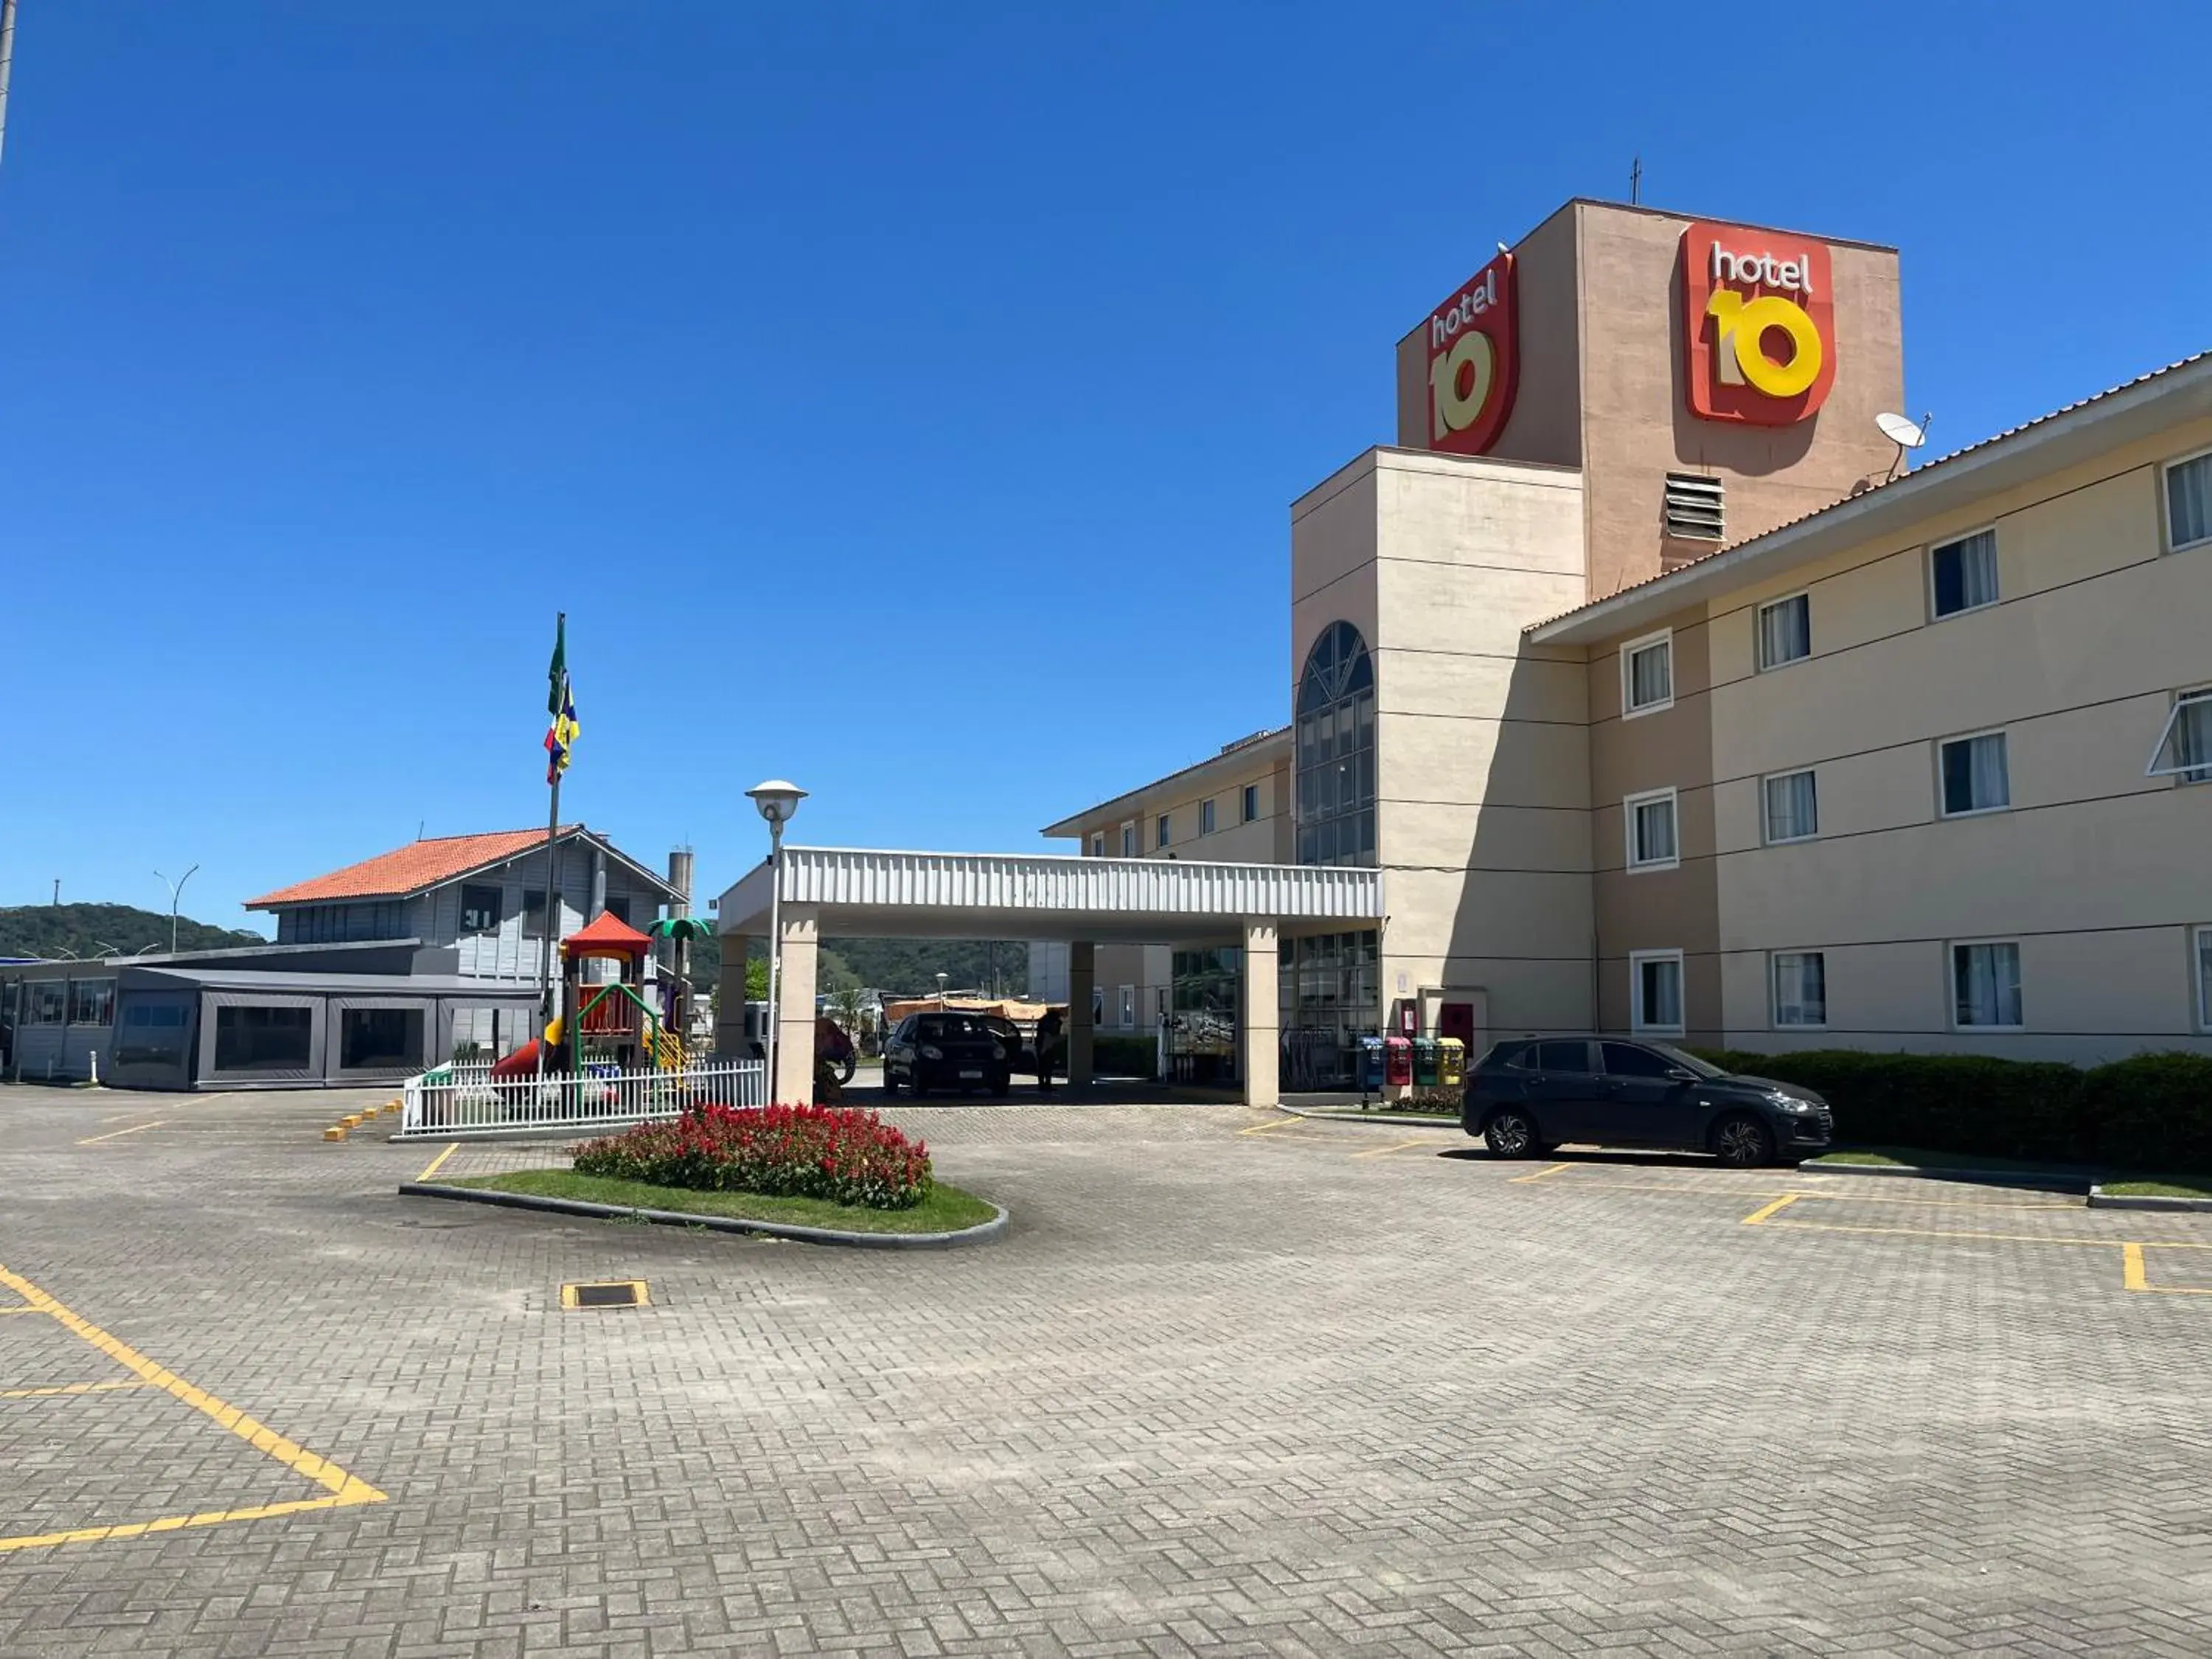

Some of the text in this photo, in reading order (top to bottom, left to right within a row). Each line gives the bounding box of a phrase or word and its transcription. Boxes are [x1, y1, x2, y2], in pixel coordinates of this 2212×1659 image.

[1432, 269, 1498, 349] hotel
[1711, 240, 1813, 294] hotel
[1429, 330, 1495, 441] 10
[1706, 290, 1823, 398] 10
